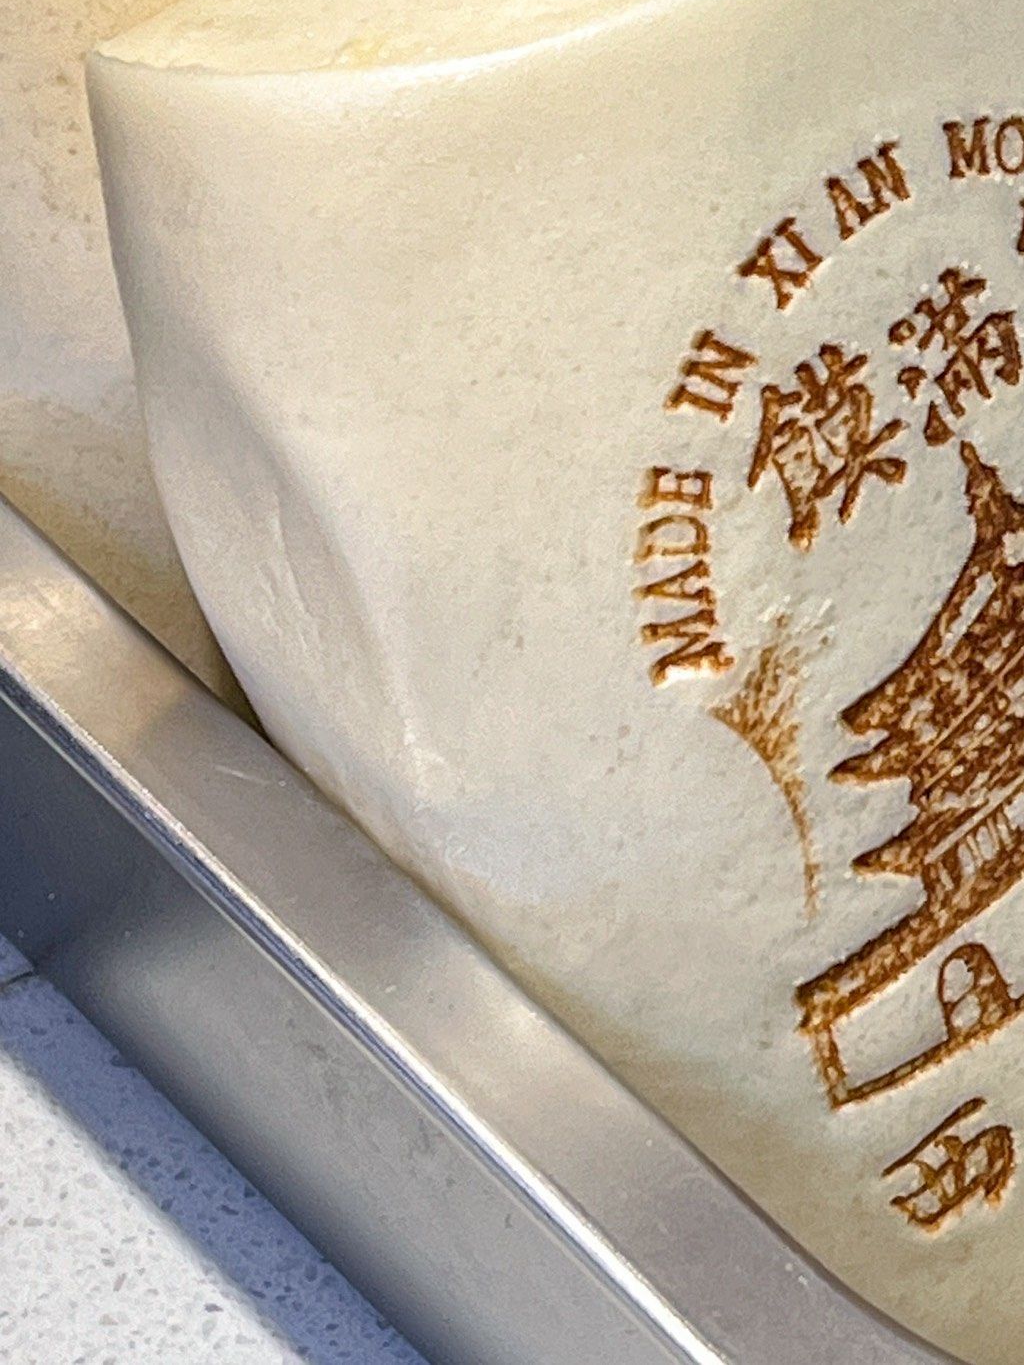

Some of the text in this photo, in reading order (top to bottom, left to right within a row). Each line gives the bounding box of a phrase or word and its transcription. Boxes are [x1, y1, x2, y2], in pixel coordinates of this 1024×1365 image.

[825, 140, 911, 240] AN
[737, 218, 824, 310] XI
[664, 330, 757, 421] IN
[635, 466, 734, 681] MADE
